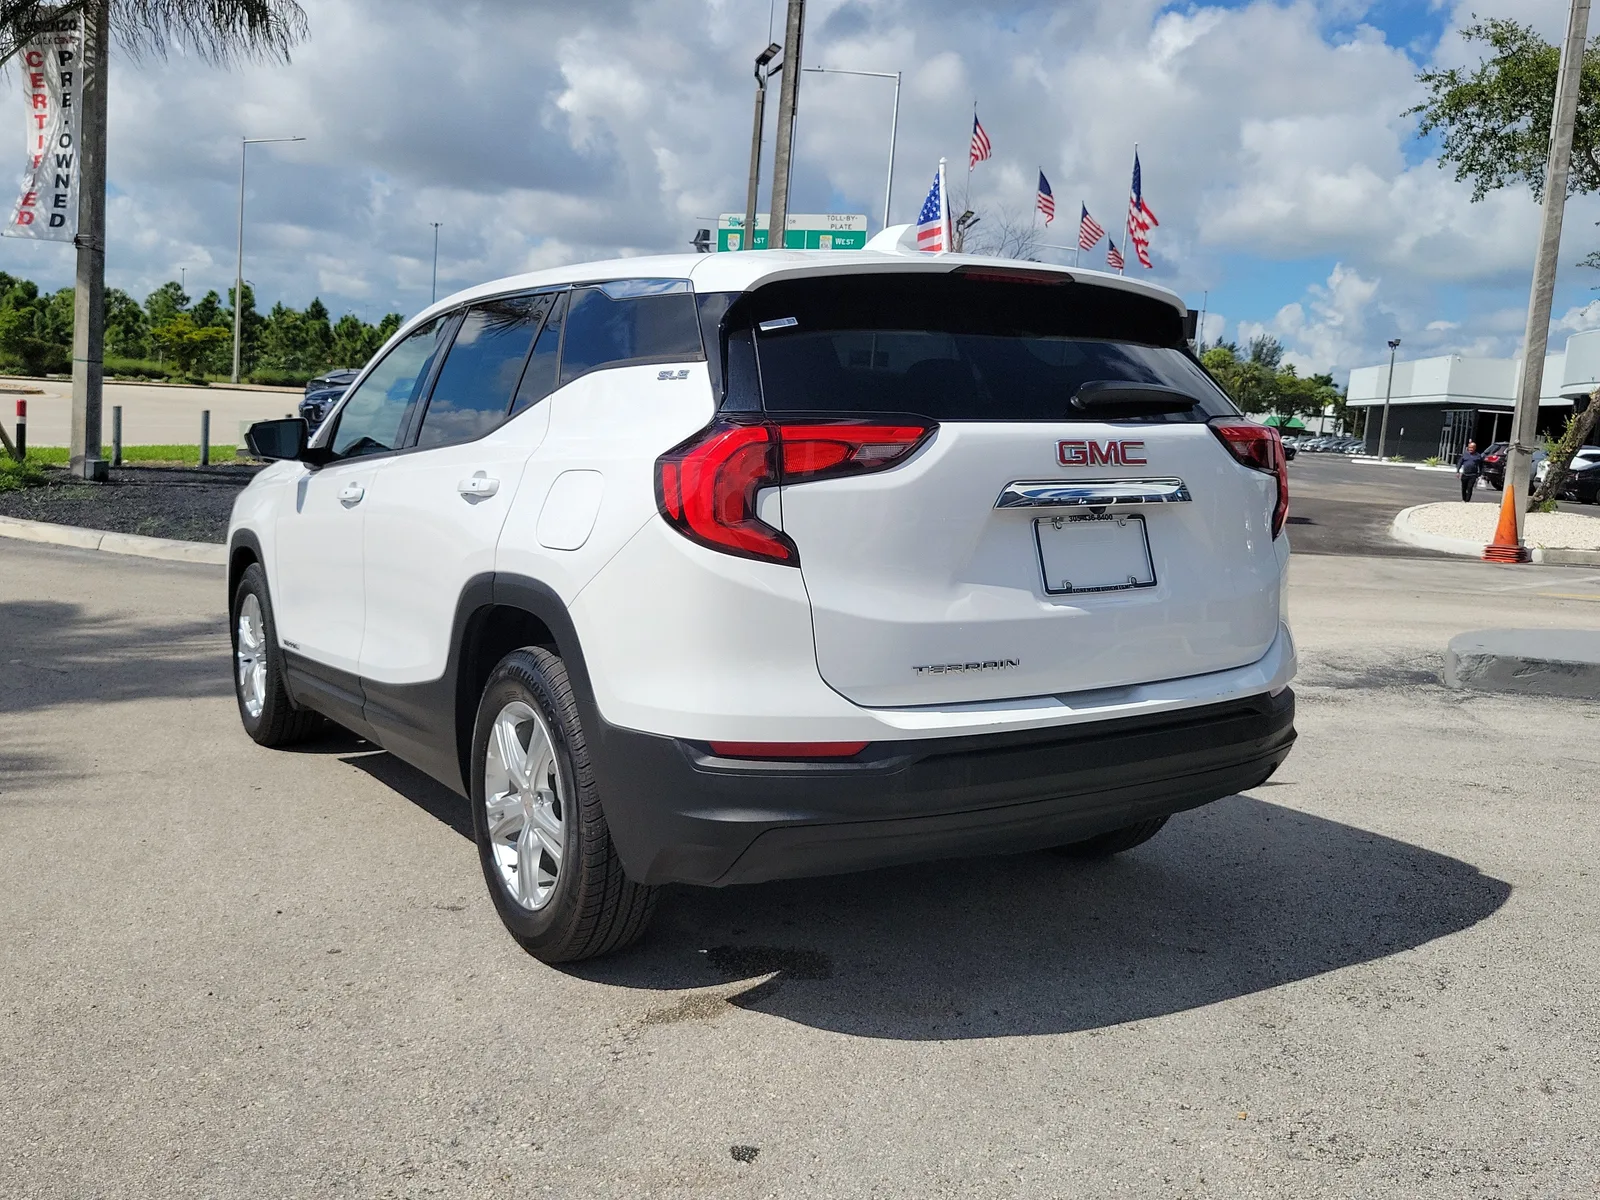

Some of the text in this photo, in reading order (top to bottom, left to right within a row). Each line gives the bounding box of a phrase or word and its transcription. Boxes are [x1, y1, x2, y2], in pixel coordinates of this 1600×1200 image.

[835, 237, 855, 245] WEST
[657, 370, 690, 380] SLE
[1055, 439, 1147, 467] GMC
[911, 658, 1020, 676] TERRAIN
